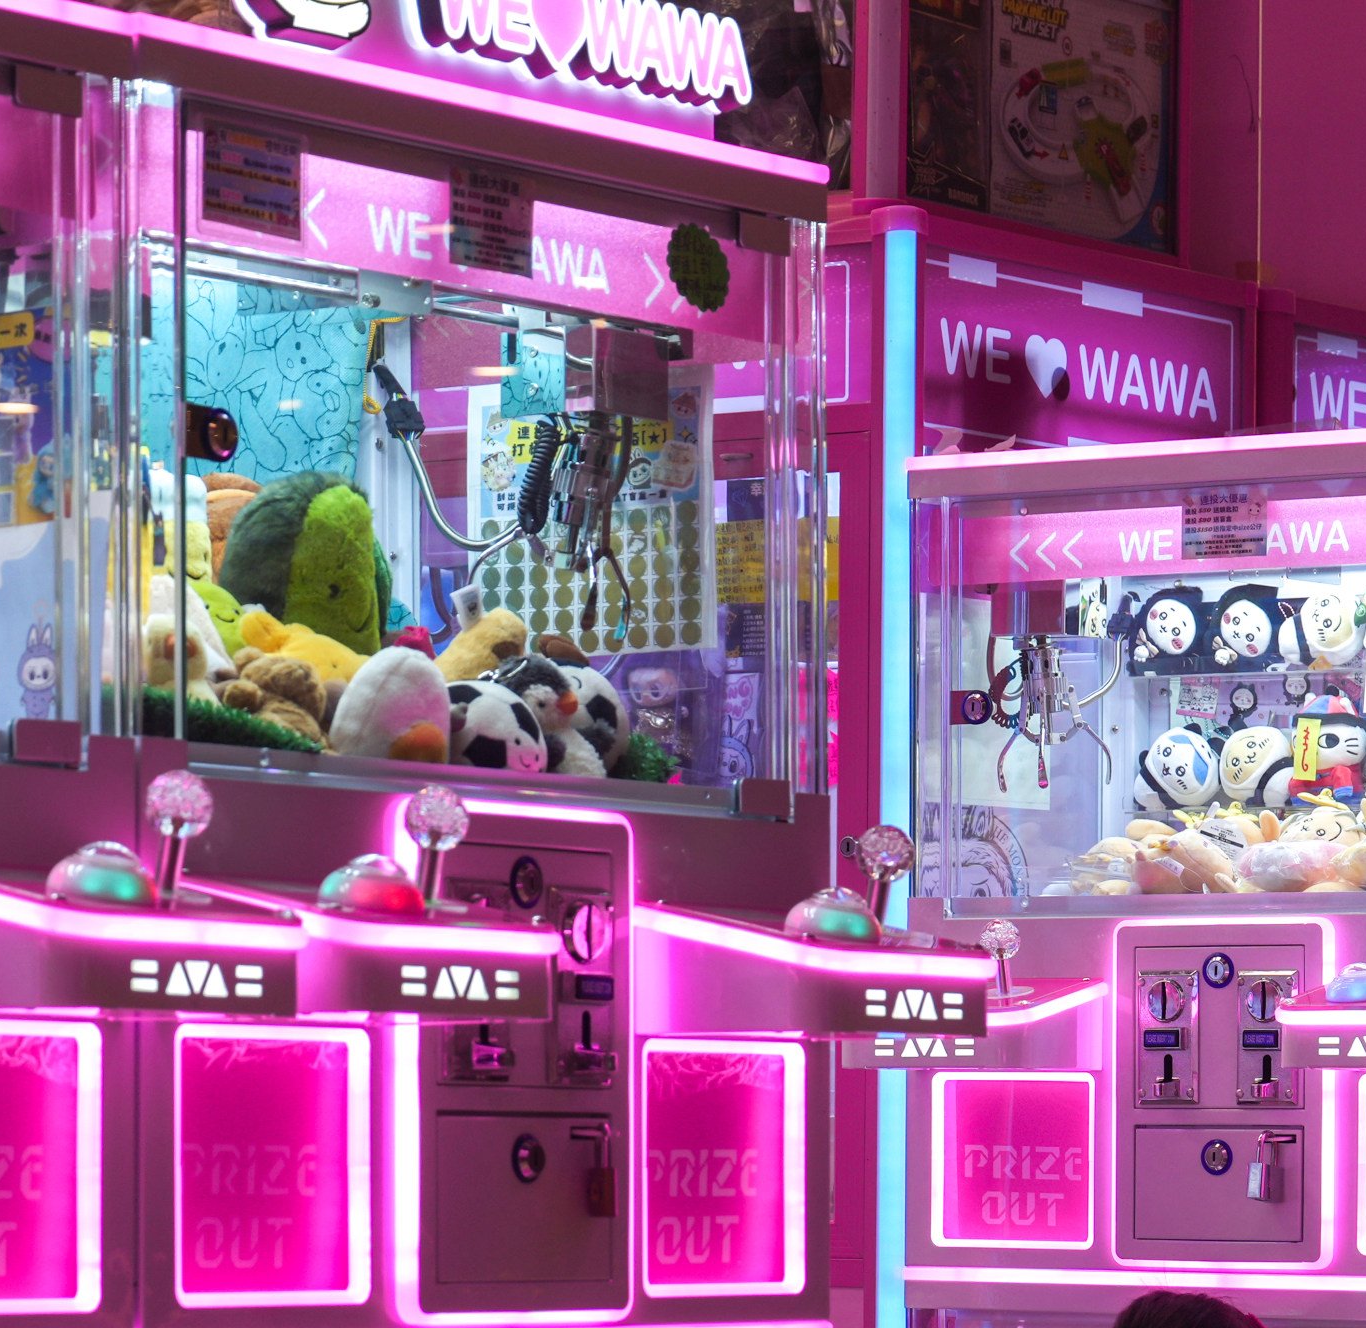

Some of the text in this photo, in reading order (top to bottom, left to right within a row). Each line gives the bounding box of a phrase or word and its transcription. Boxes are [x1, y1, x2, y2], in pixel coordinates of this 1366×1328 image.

[585, 0, 751, 104] WAWA
[366, 203, 433, 260] WE
[532, 235, 610, 294] AWA
[940, 317, 1217, 425] WE WAWA
[1119, 529, 1173, 561] WE
[1267, 519, 1350, 554] AWA
[649, 1148, 758, 1198] PRIZE
[964, 1146, 1082, 1181] PRIZE
[981, 1190, 1064, 1227] OUT
[193, 1216, 292, 1270] OUT
[656, 1215, 740, 1267] OUT
